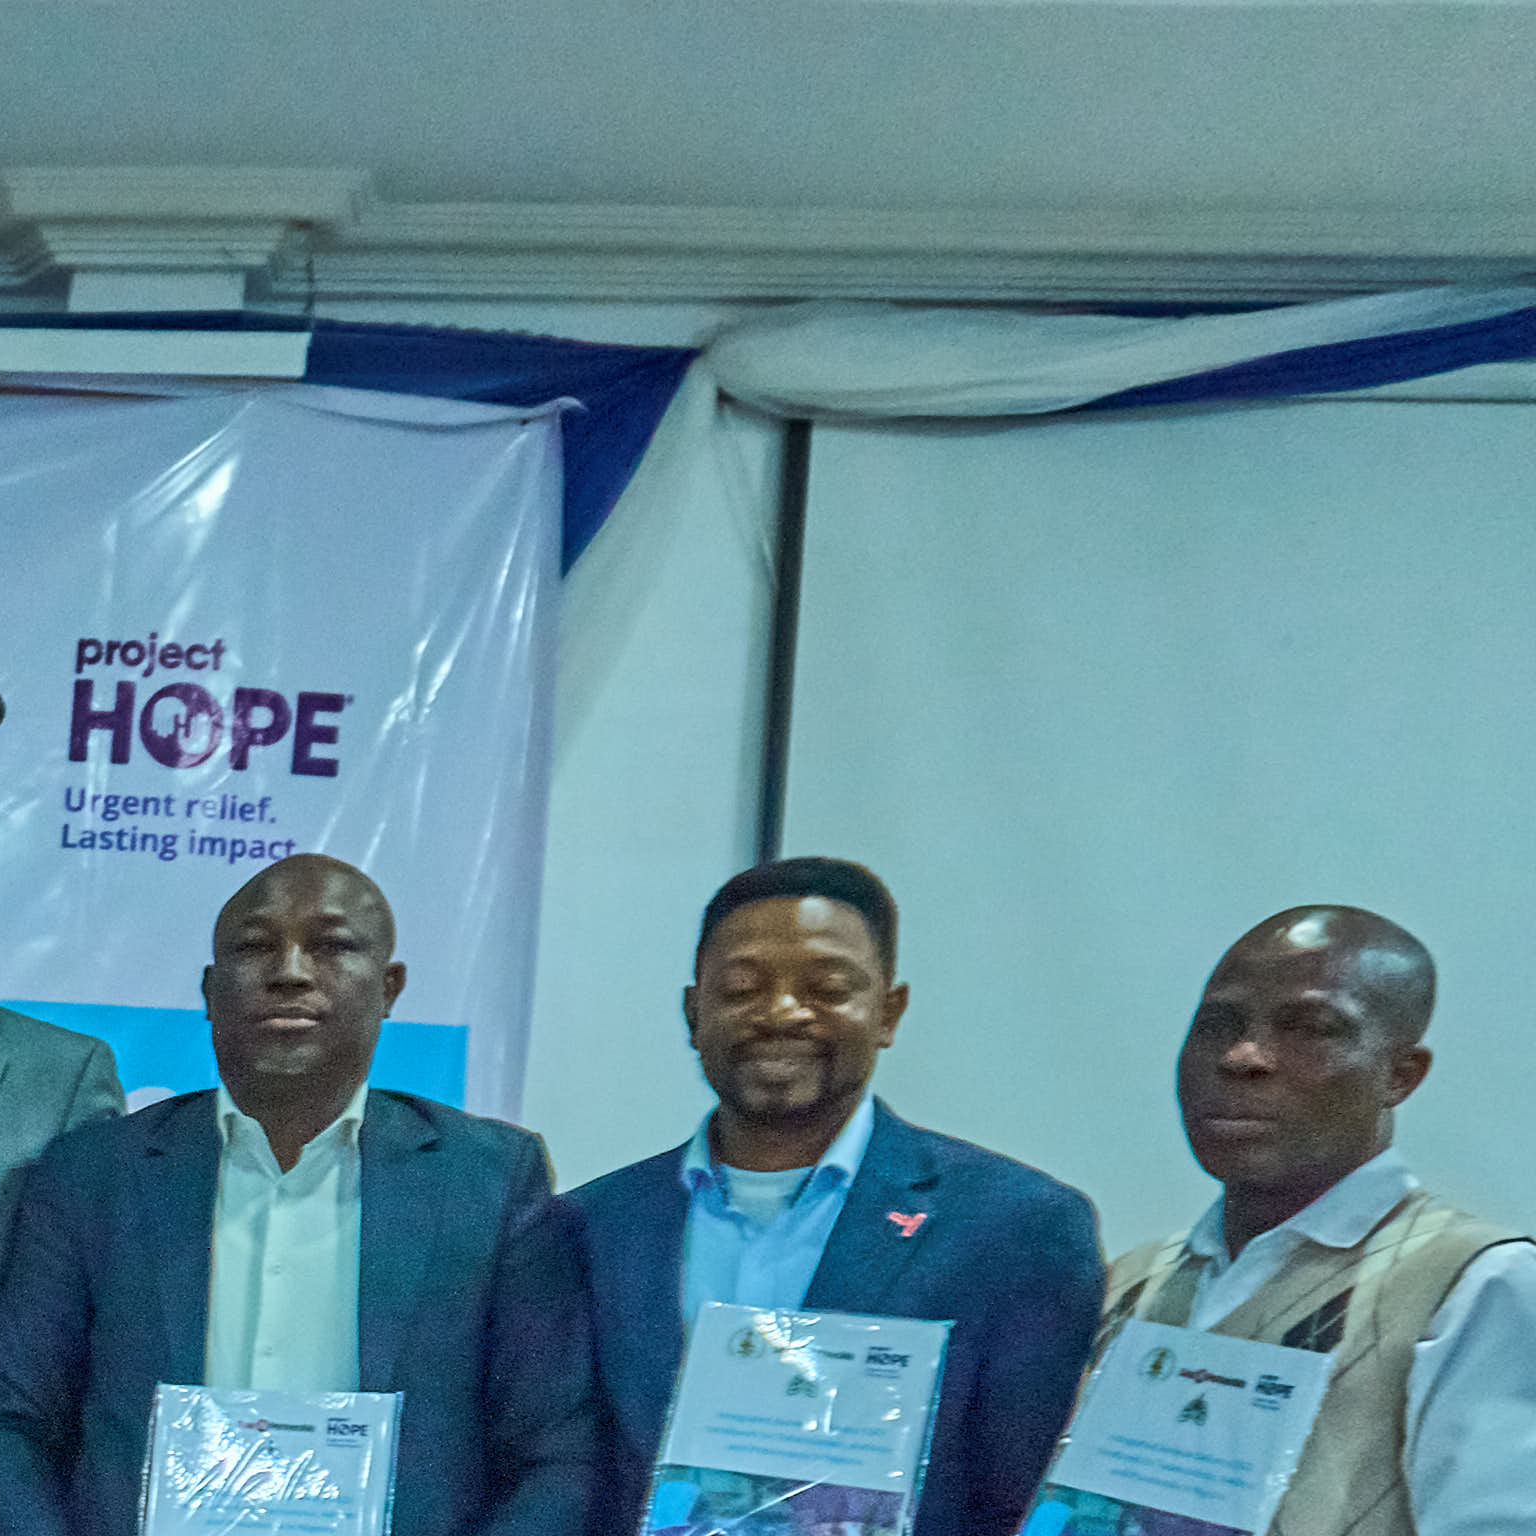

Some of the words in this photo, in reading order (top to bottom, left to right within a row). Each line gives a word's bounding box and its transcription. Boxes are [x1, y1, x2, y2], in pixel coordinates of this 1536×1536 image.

[76, 632, 227, 677] project
[69, 679, 347, 777] HOPE
[65, 787, 175, 822] Urgent
[186, 794, 277, 824] relief.
[61, 824, 178, 861] Lasting
[188, 829, 296, 865] impact
